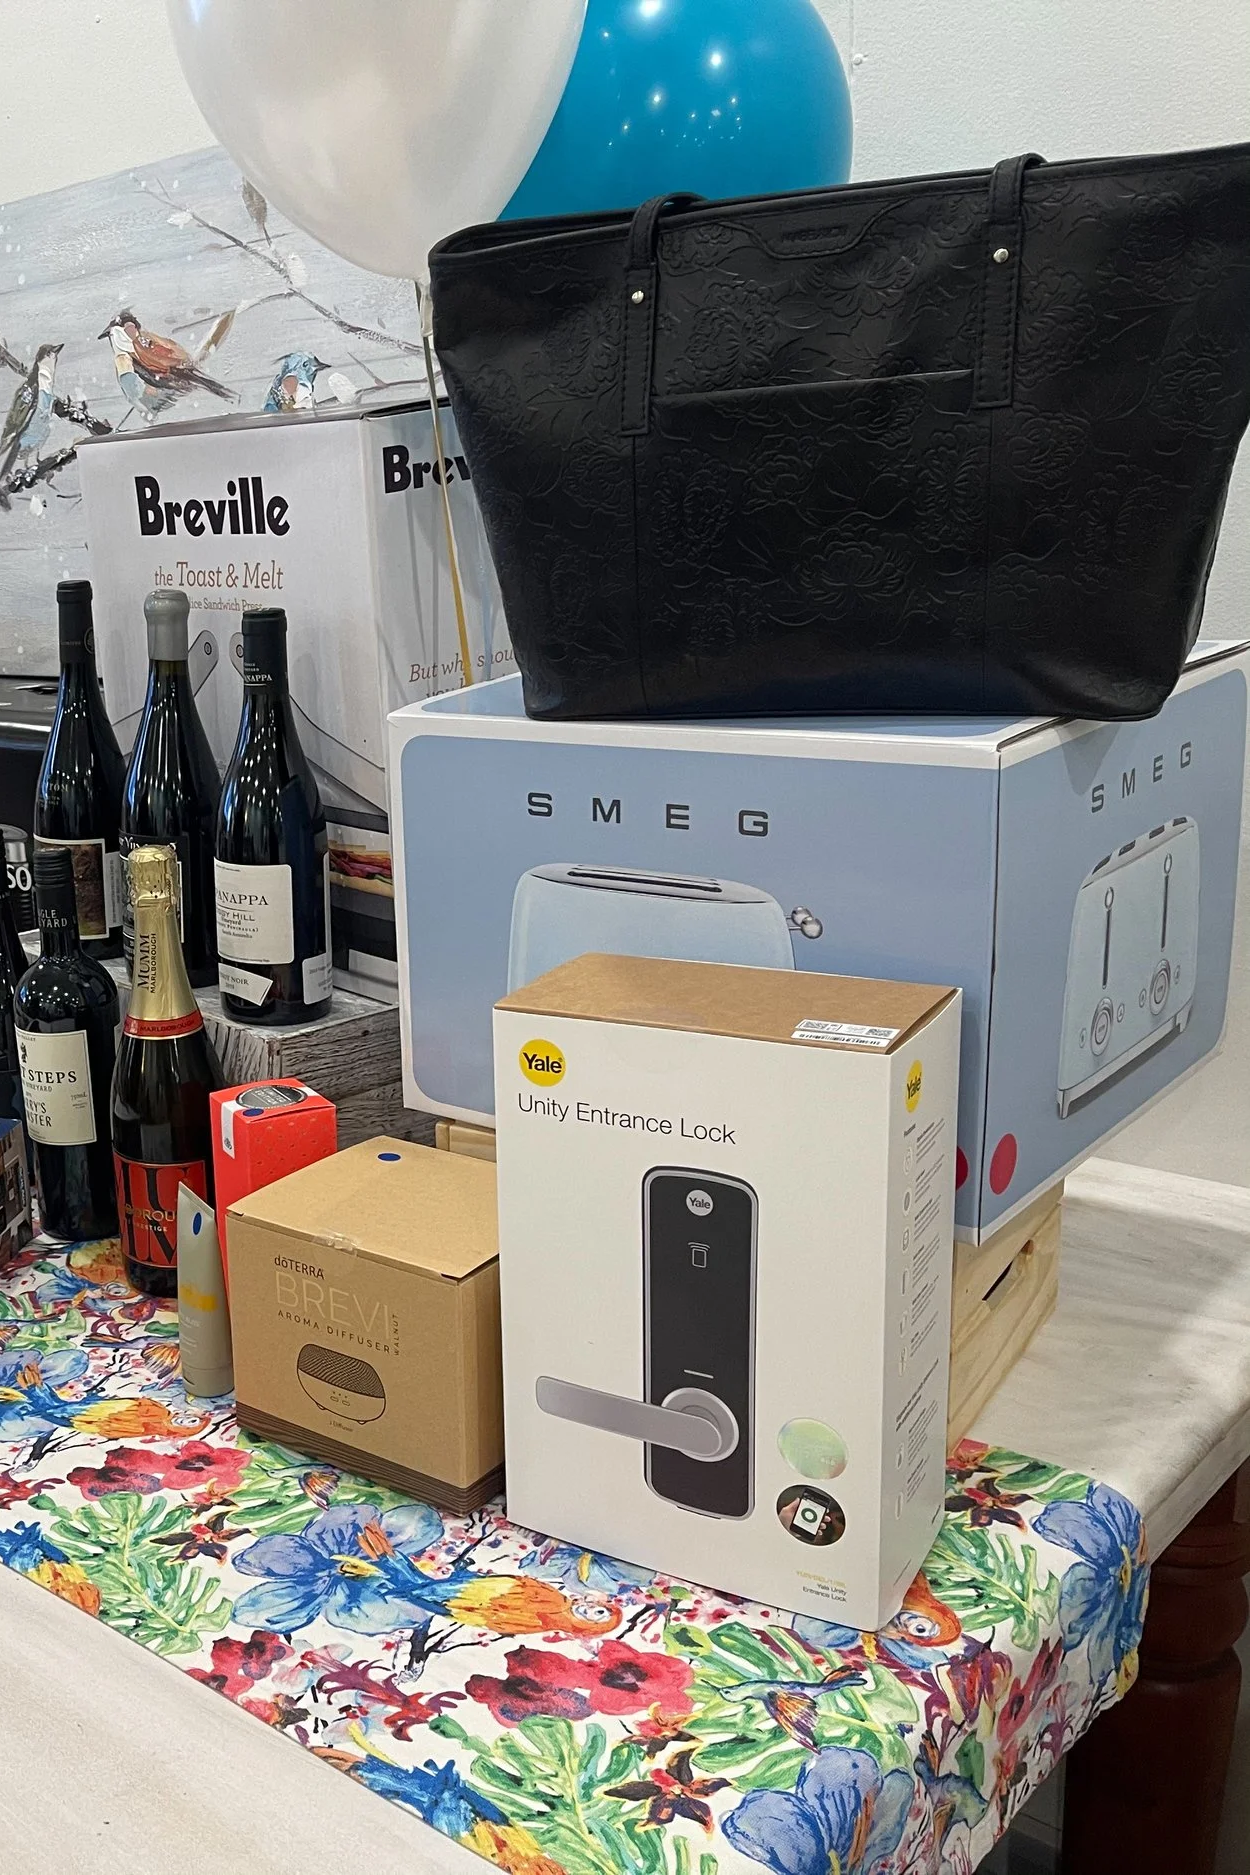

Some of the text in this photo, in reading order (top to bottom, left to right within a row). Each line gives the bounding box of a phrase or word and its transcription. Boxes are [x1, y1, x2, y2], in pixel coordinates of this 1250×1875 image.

[382, 444, 472, 494] Brev
[135, 475, 291, 537] Breville
[155, 560, 284, 590] the Toast & Melt
[188, 596, 203, 610] lice
[203, 596, 240, 612] Sandwich
[244, 673, 273, 683] NAPPA
[409, 661, 439, 683] But
[442, 652, 466, 675] wh
[1091, 741, 1192, 813] SMEG
[527, 791, 769, 837] SMEG
[137, 933, 150, 990] MUMM
[28, 1069, 77, 1084] STEPS
[522, 1051, 563, 1074] Yale
[906, 1071, 922, 1100] Yale
[518, 1092, 737, 1145] Unity Entrance Lock
[688, 1196, 711, 1210] Yale
[275, 1270, 391, 1340] BREVI
[277, 1309, 391, 1354] AROMA DIFFUSER
[391, 1313, 400, 1356] WALNUT
[802, 1585, 847, 1603] Entrance Lock
[816, 1583, 848, 1596] Yale Unity
